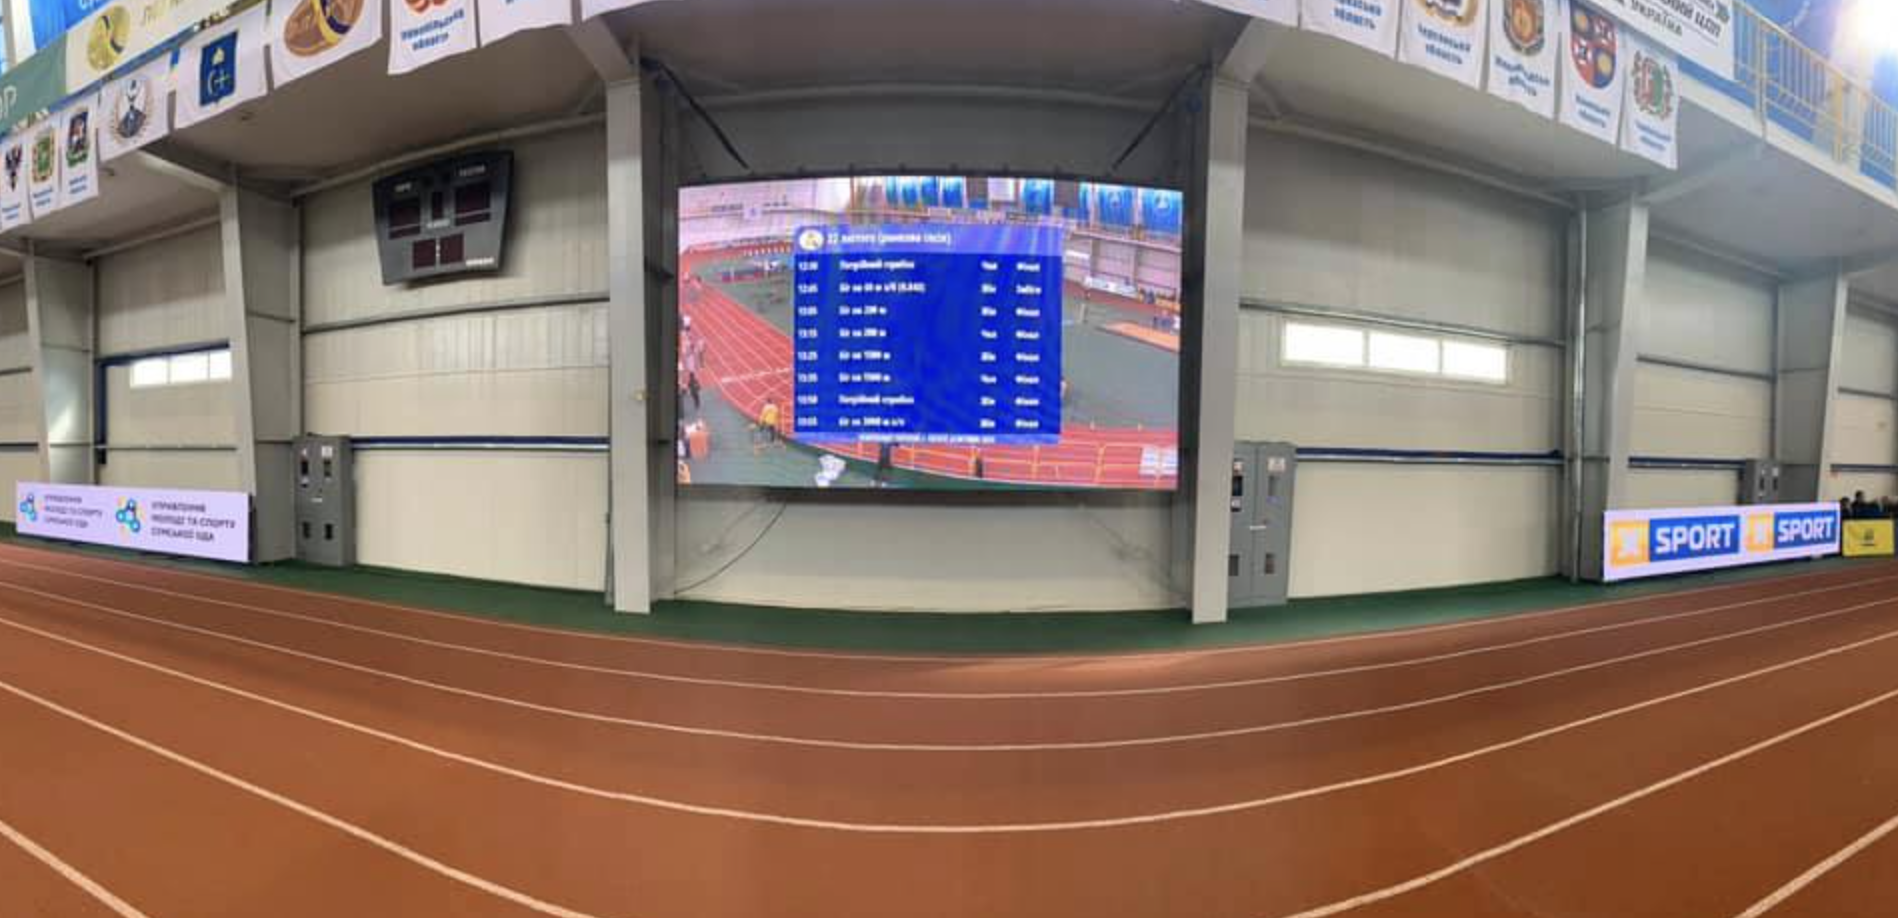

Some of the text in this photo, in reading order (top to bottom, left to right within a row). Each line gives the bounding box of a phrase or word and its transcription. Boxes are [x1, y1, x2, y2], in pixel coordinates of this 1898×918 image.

[199, 516, 236, 529] СПОРТУ
[1777, 516, 1835, 543] SPORT
[1654, 522, 1735, 555] SPORT
